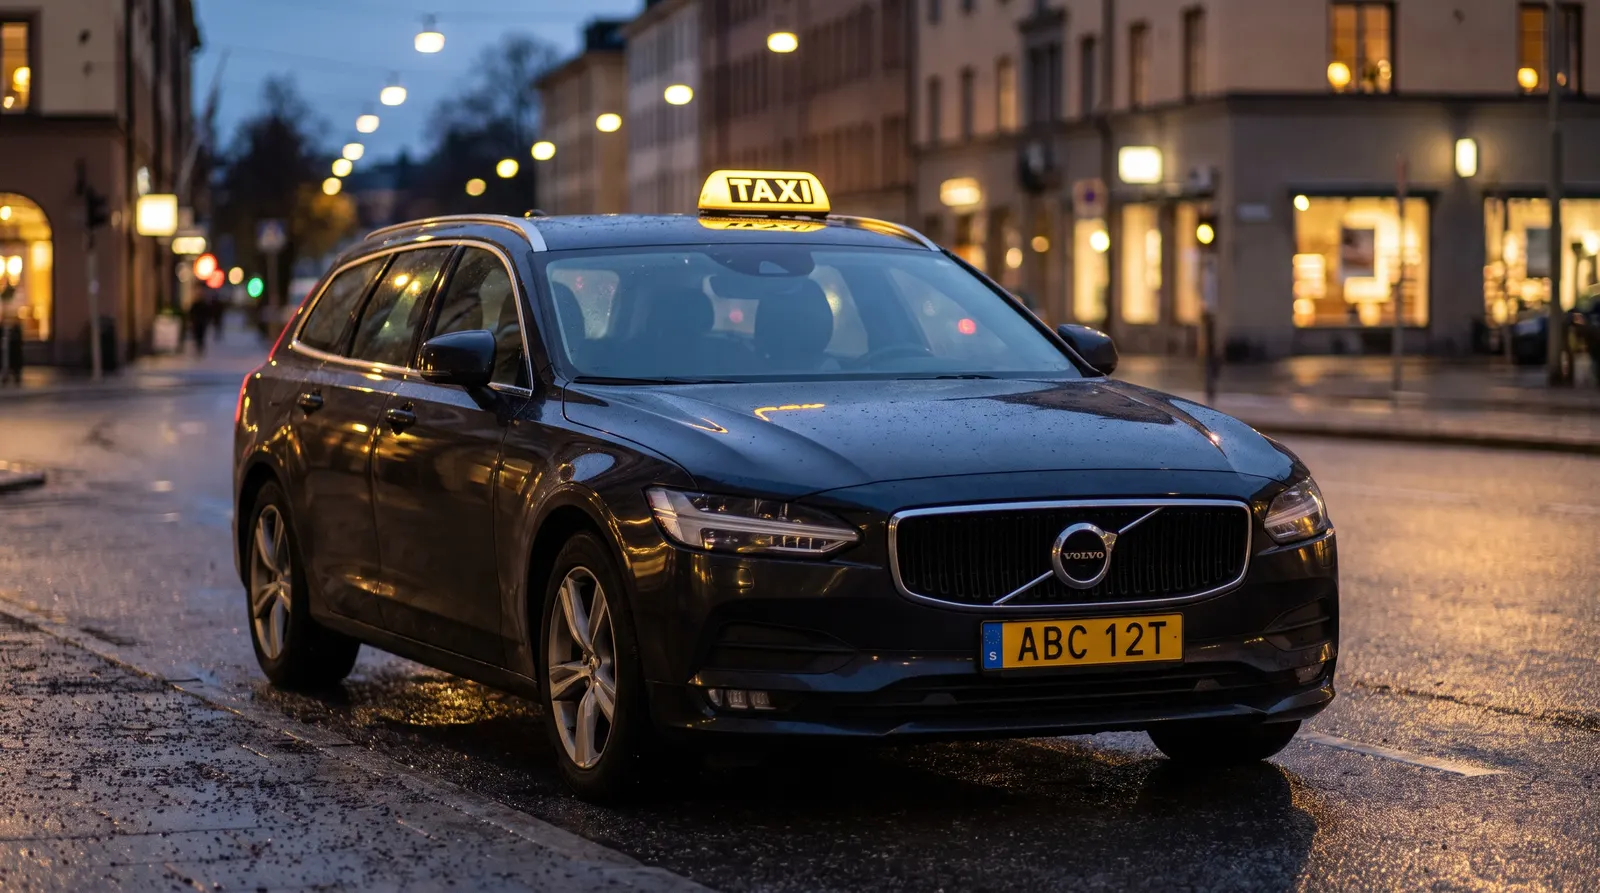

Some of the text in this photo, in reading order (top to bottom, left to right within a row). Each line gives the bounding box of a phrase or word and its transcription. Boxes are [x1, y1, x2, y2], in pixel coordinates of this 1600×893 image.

[728, 178, 812, 203] TAXI
[1063, 551, 1105, 560] VOLVO
[1018, 621, 1167, 661] ABC 12T
[989, 651, 997, 661] S
